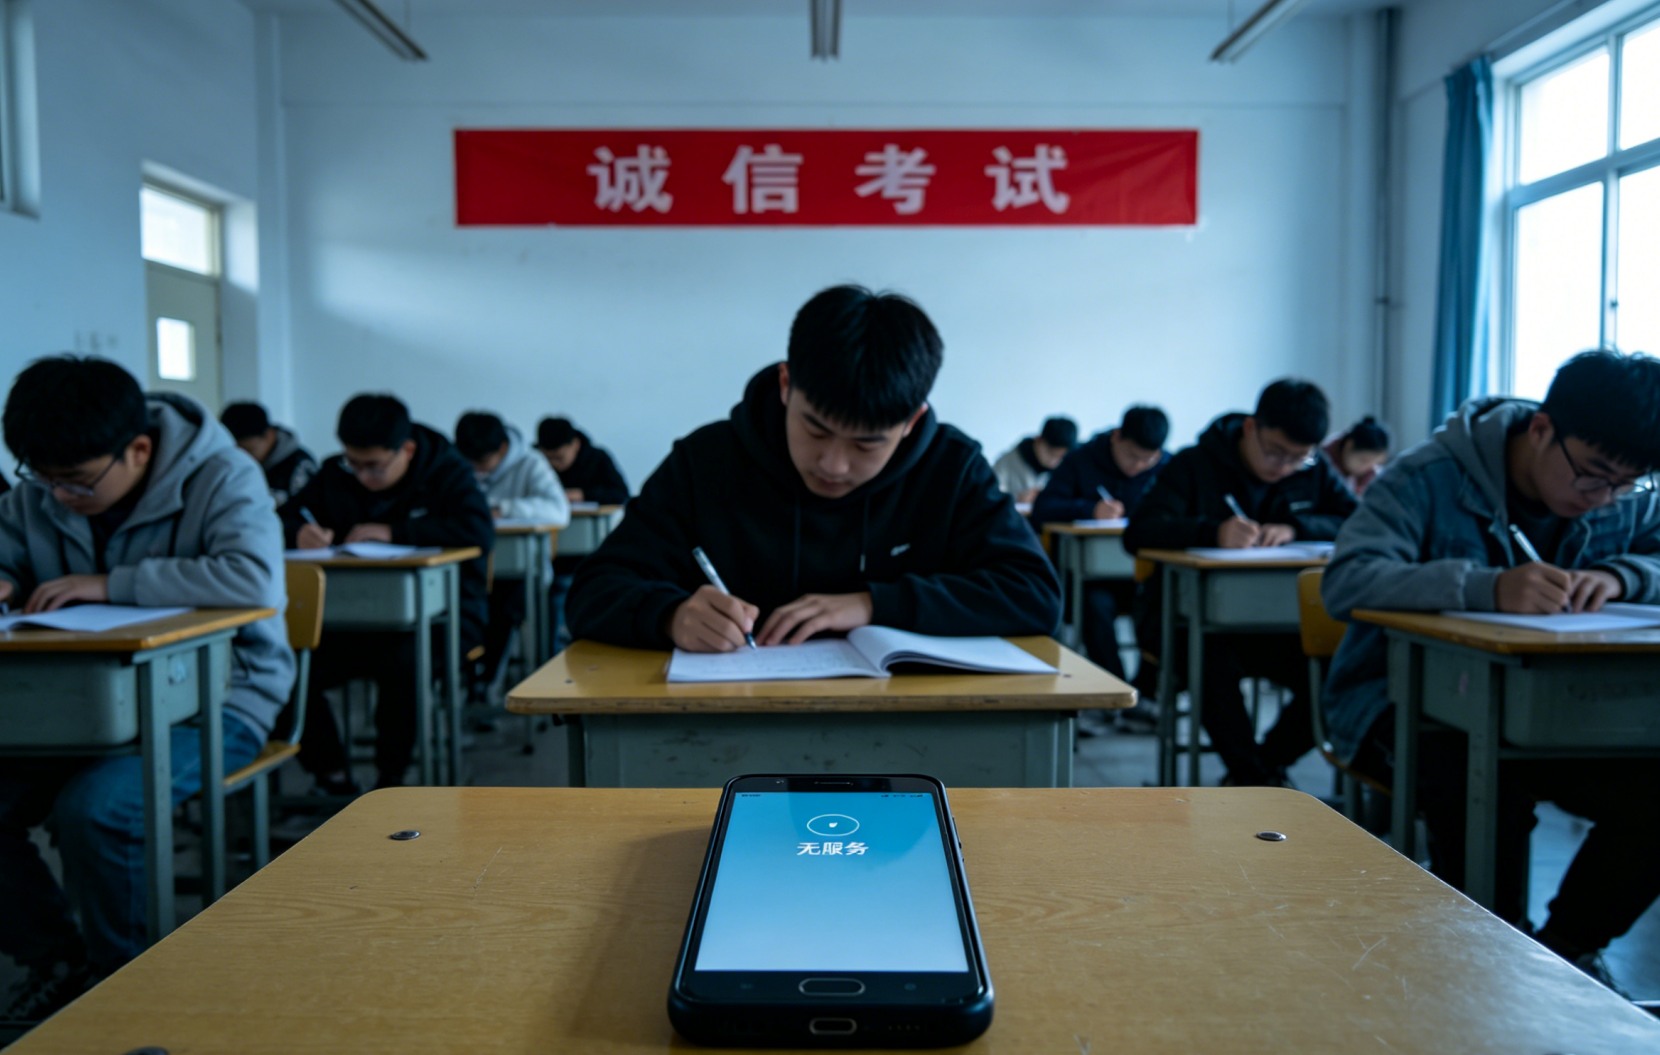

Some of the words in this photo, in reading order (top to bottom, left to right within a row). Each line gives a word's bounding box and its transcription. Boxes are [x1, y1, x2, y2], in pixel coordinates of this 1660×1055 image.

[587, 144, 1070, 215] 诚信考试
[796, 841, 869, 856] 无服务
